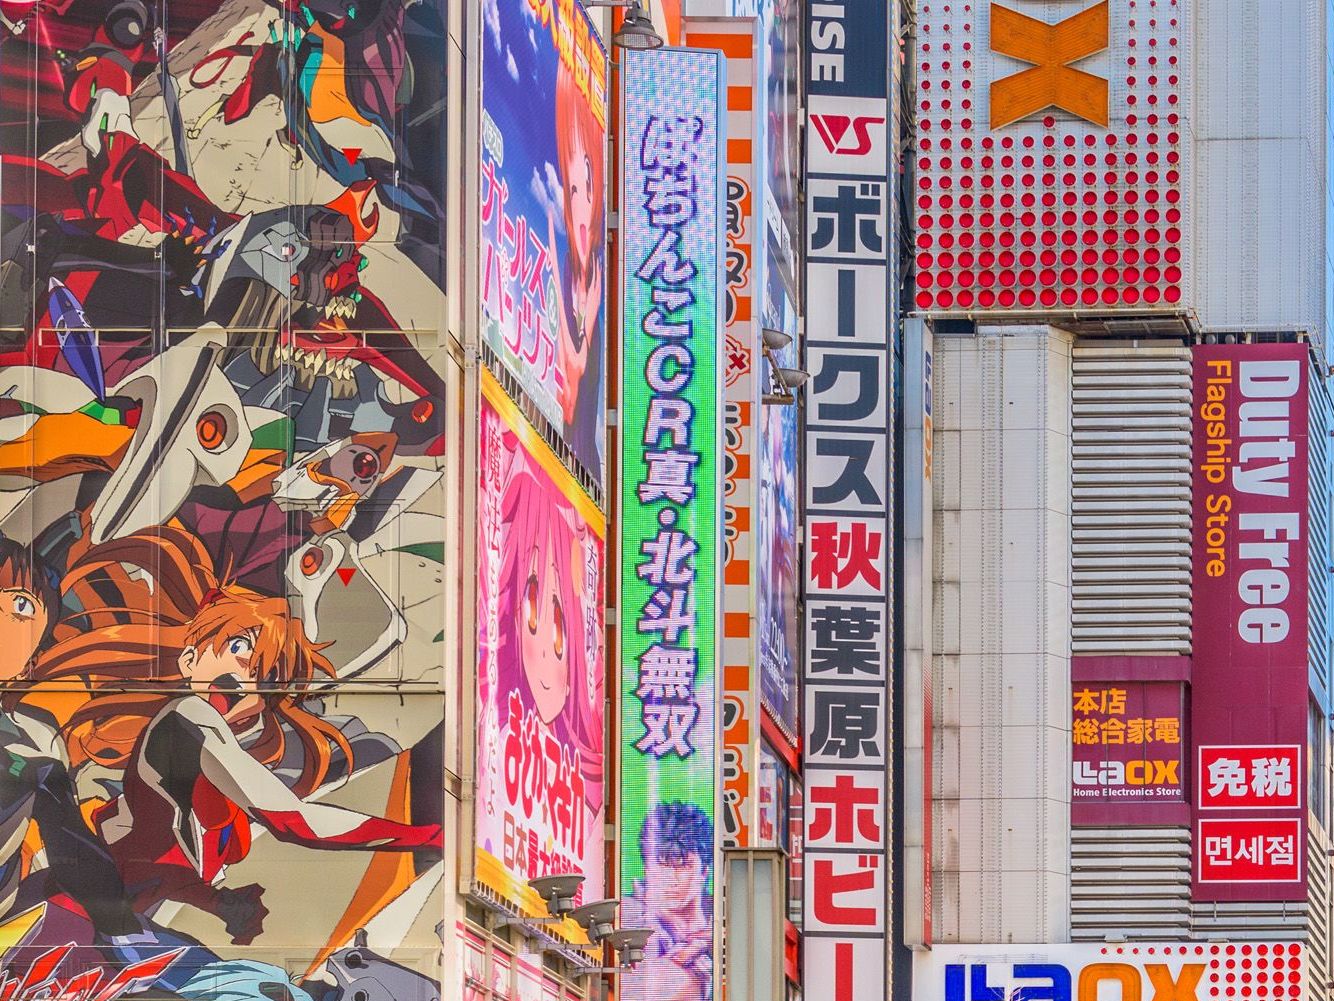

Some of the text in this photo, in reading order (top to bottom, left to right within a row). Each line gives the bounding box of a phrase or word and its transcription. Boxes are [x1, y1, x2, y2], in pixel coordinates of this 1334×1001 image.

[811, 0, 845, 82] ISE
[636, 113, 703, 760] ぱちんこCR真・北斗無双
[1201, 360, 1232, 577] Flagship Store
[1232, 360, 1300, 643] Duty Free
[1073, 688, 1127, 714] 本店
[1073, 718, 1180, 744] 総合家電
[1073, 787, 1181, 797] Home Electronics Store
[1207, 757, 1293, 798] 免税
[1205, 835, 1294, 866] 면세점
